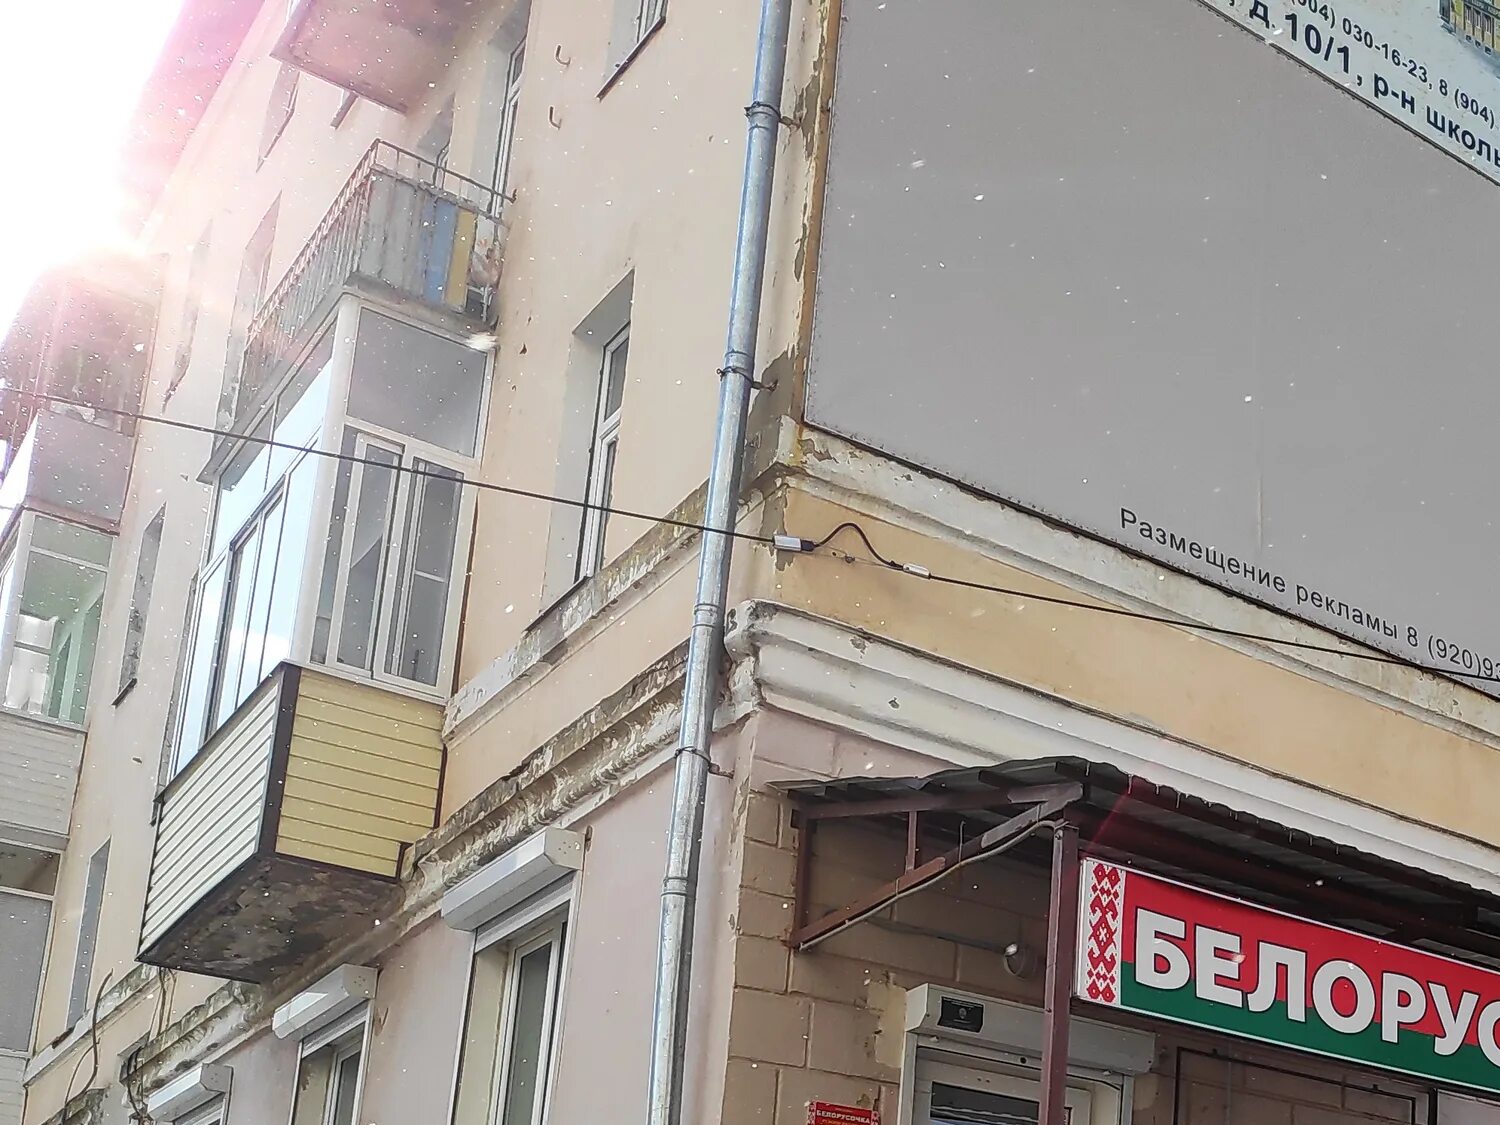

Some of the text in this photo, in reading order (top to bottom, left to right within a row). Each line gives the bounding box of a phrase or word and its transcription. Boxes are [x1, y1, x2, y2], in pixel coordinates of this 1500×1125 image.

[1291, 0, 1336, 29] 04)
[1439, 78, 1449, 97] 8
[1454, 88, 1496, 129] (904)
[1374, 73, 1416, 115] р-н
[1120, 507, 1286, 593] Размещение
[1296, 584, 1398, 640] рекламы
[1407, 626, 1419, 648] 8
[816, 1109, 871, 1124] БЕЛОРУСОЧКА
